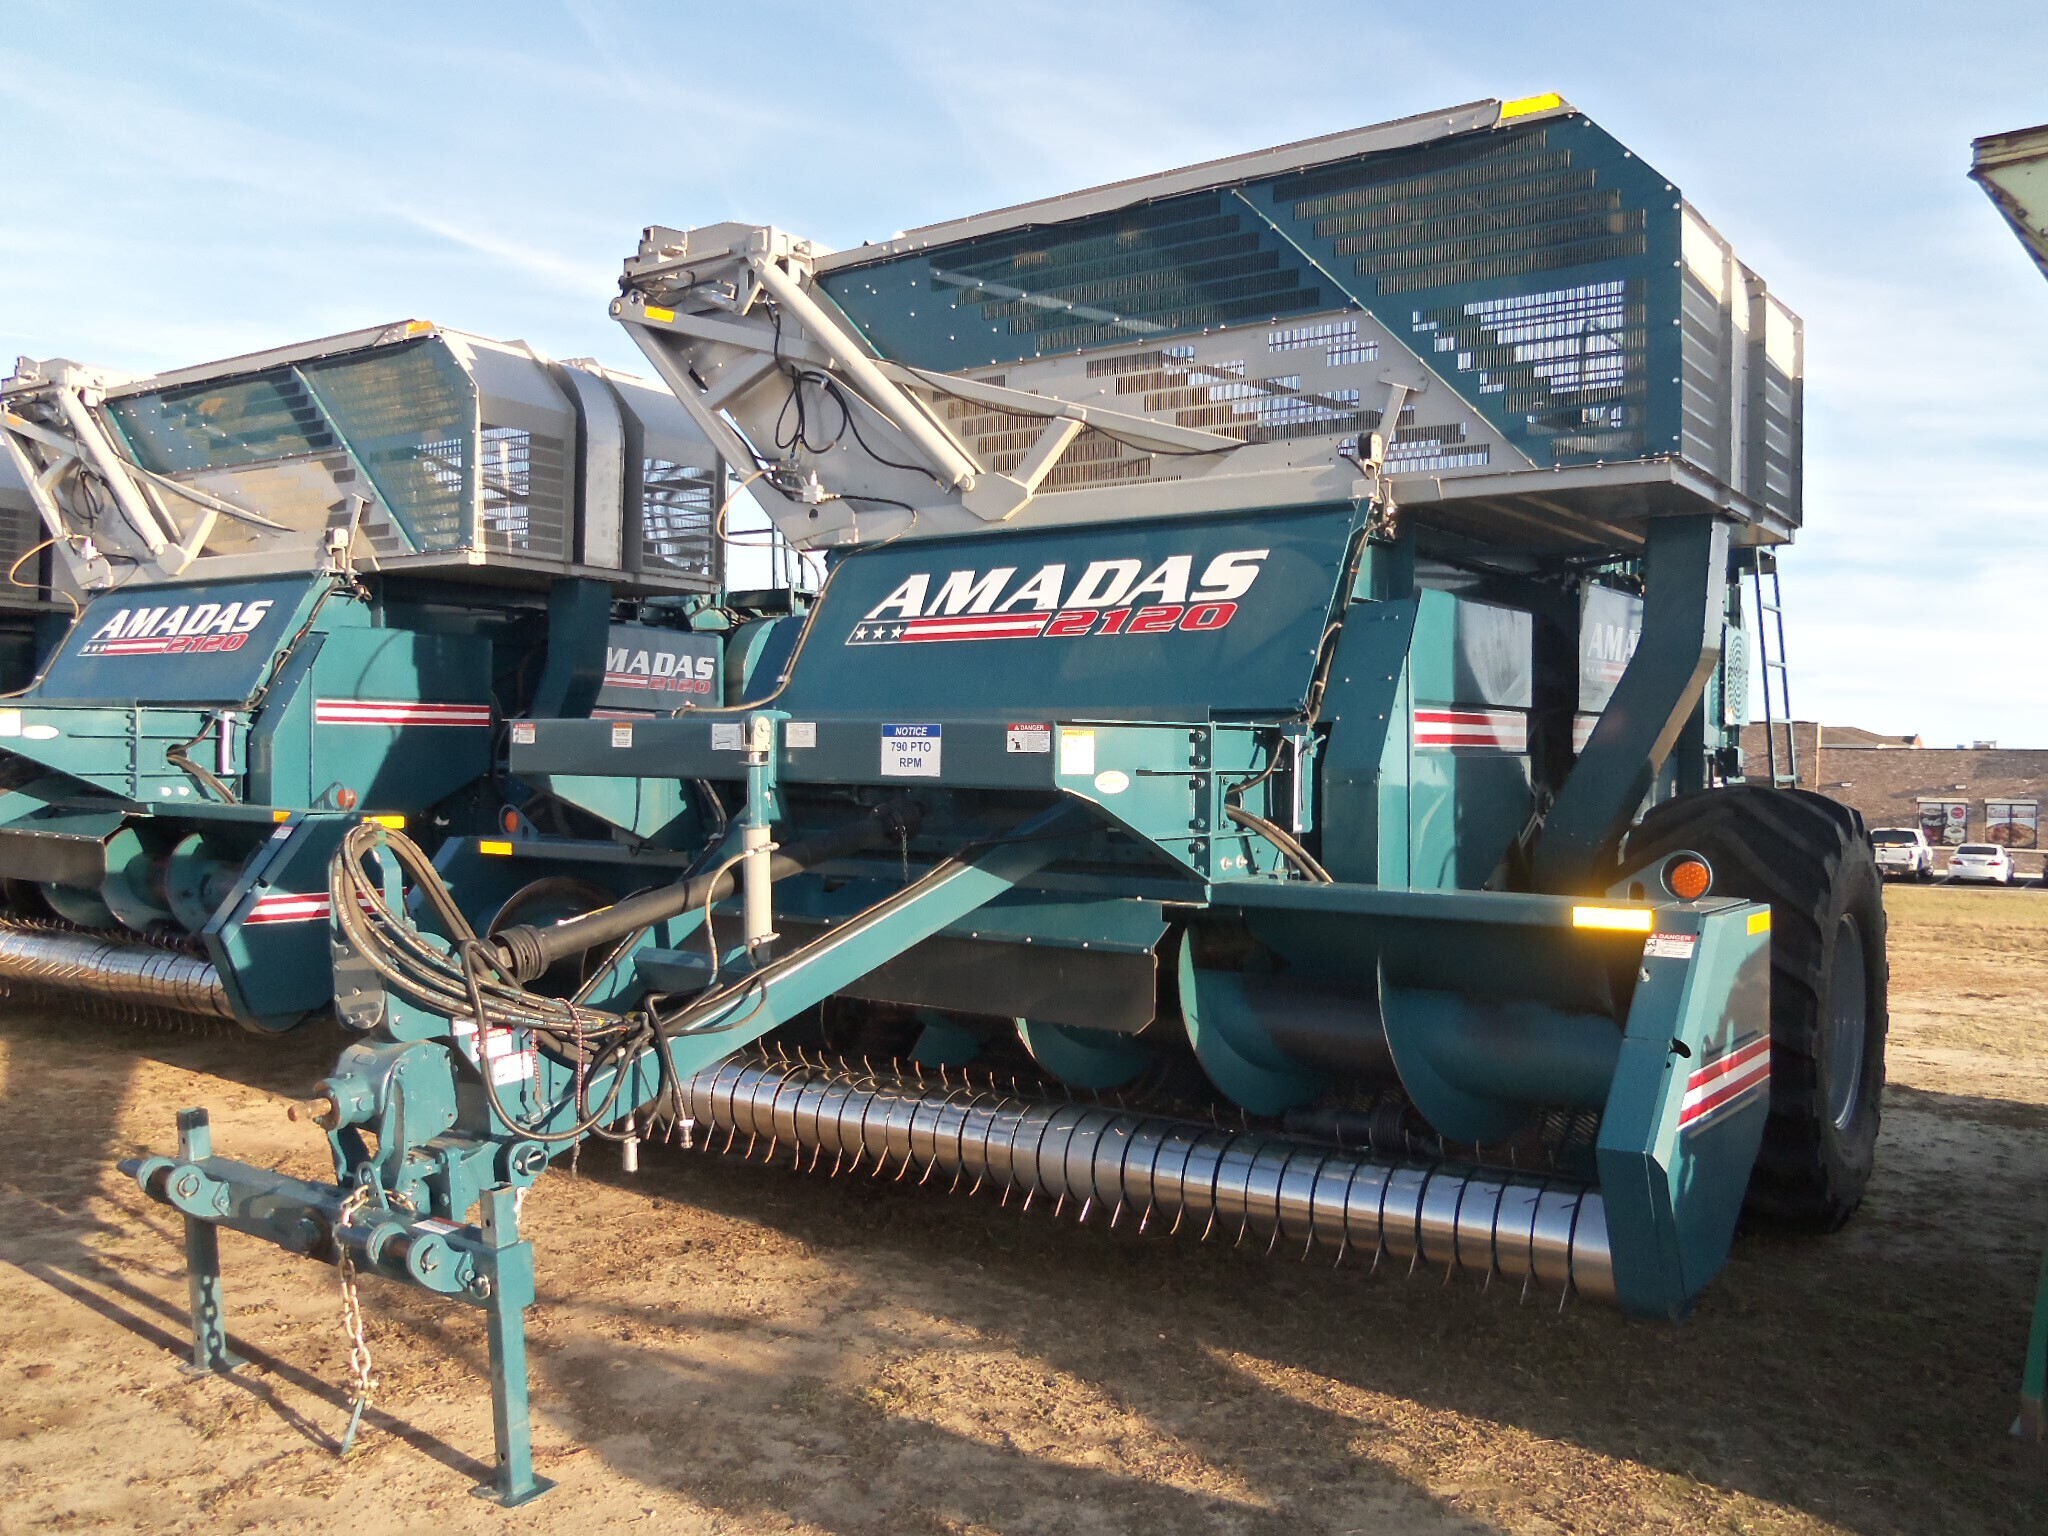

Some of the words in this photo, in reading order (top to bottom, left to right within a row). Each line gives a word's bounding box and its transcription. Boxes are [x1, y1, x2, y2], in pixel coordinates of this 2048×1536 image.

[864, 549, 1270, 619] AMADAS
[93, 600, 275, 638] AMADAS
[1042, 602, 1239, 638] 2120
[163, 633, 250, 654] 2120
[1587, 622, 1641, 662] AMA
[648, 676, 711, 694] 2120
[895, 727, 928, 736] NOTICE
[891, 741, 908, 752] 790
[910, 741, 932, 752] PTO
[899, 758, 922, 768] RPM
[1658, 933, 1691, 941] DANGER
